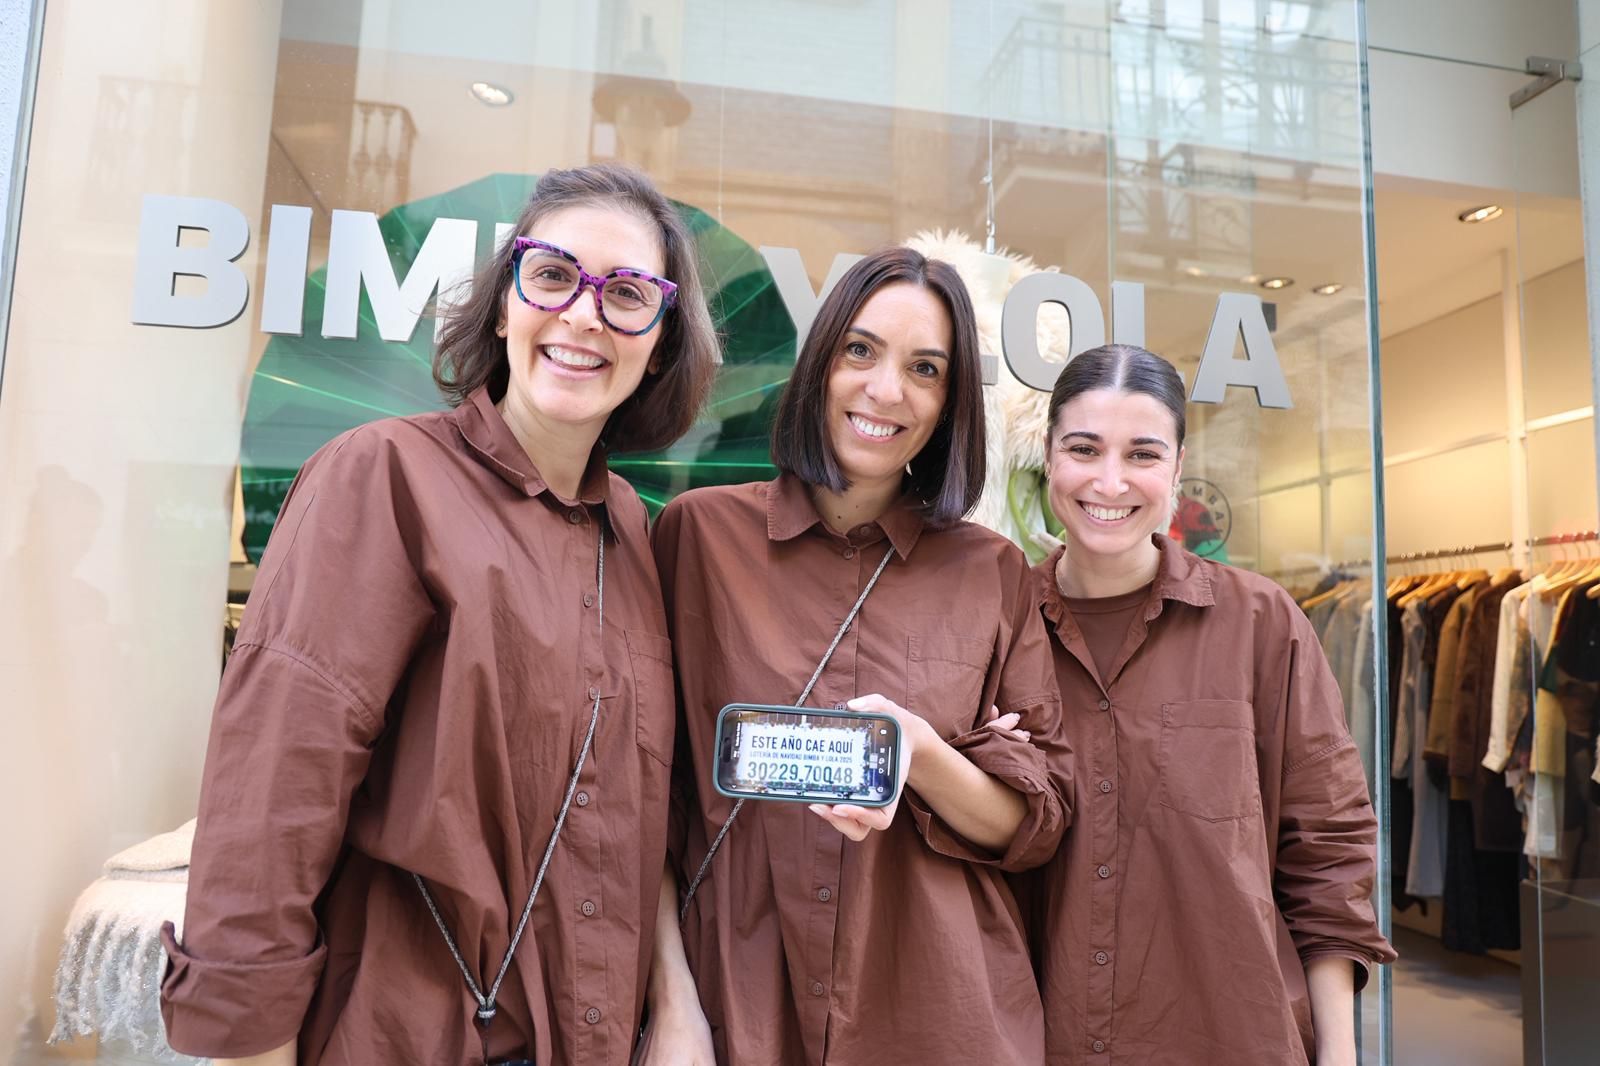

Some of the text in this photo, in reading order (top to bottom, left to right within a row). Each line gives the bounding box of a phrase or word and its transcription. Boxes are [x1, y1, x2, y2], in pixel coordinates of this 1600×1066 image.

[980, 272, 1293, 409] OA
[751, 735, 853, 754] ESTE AÑO CAE AQUÍ
